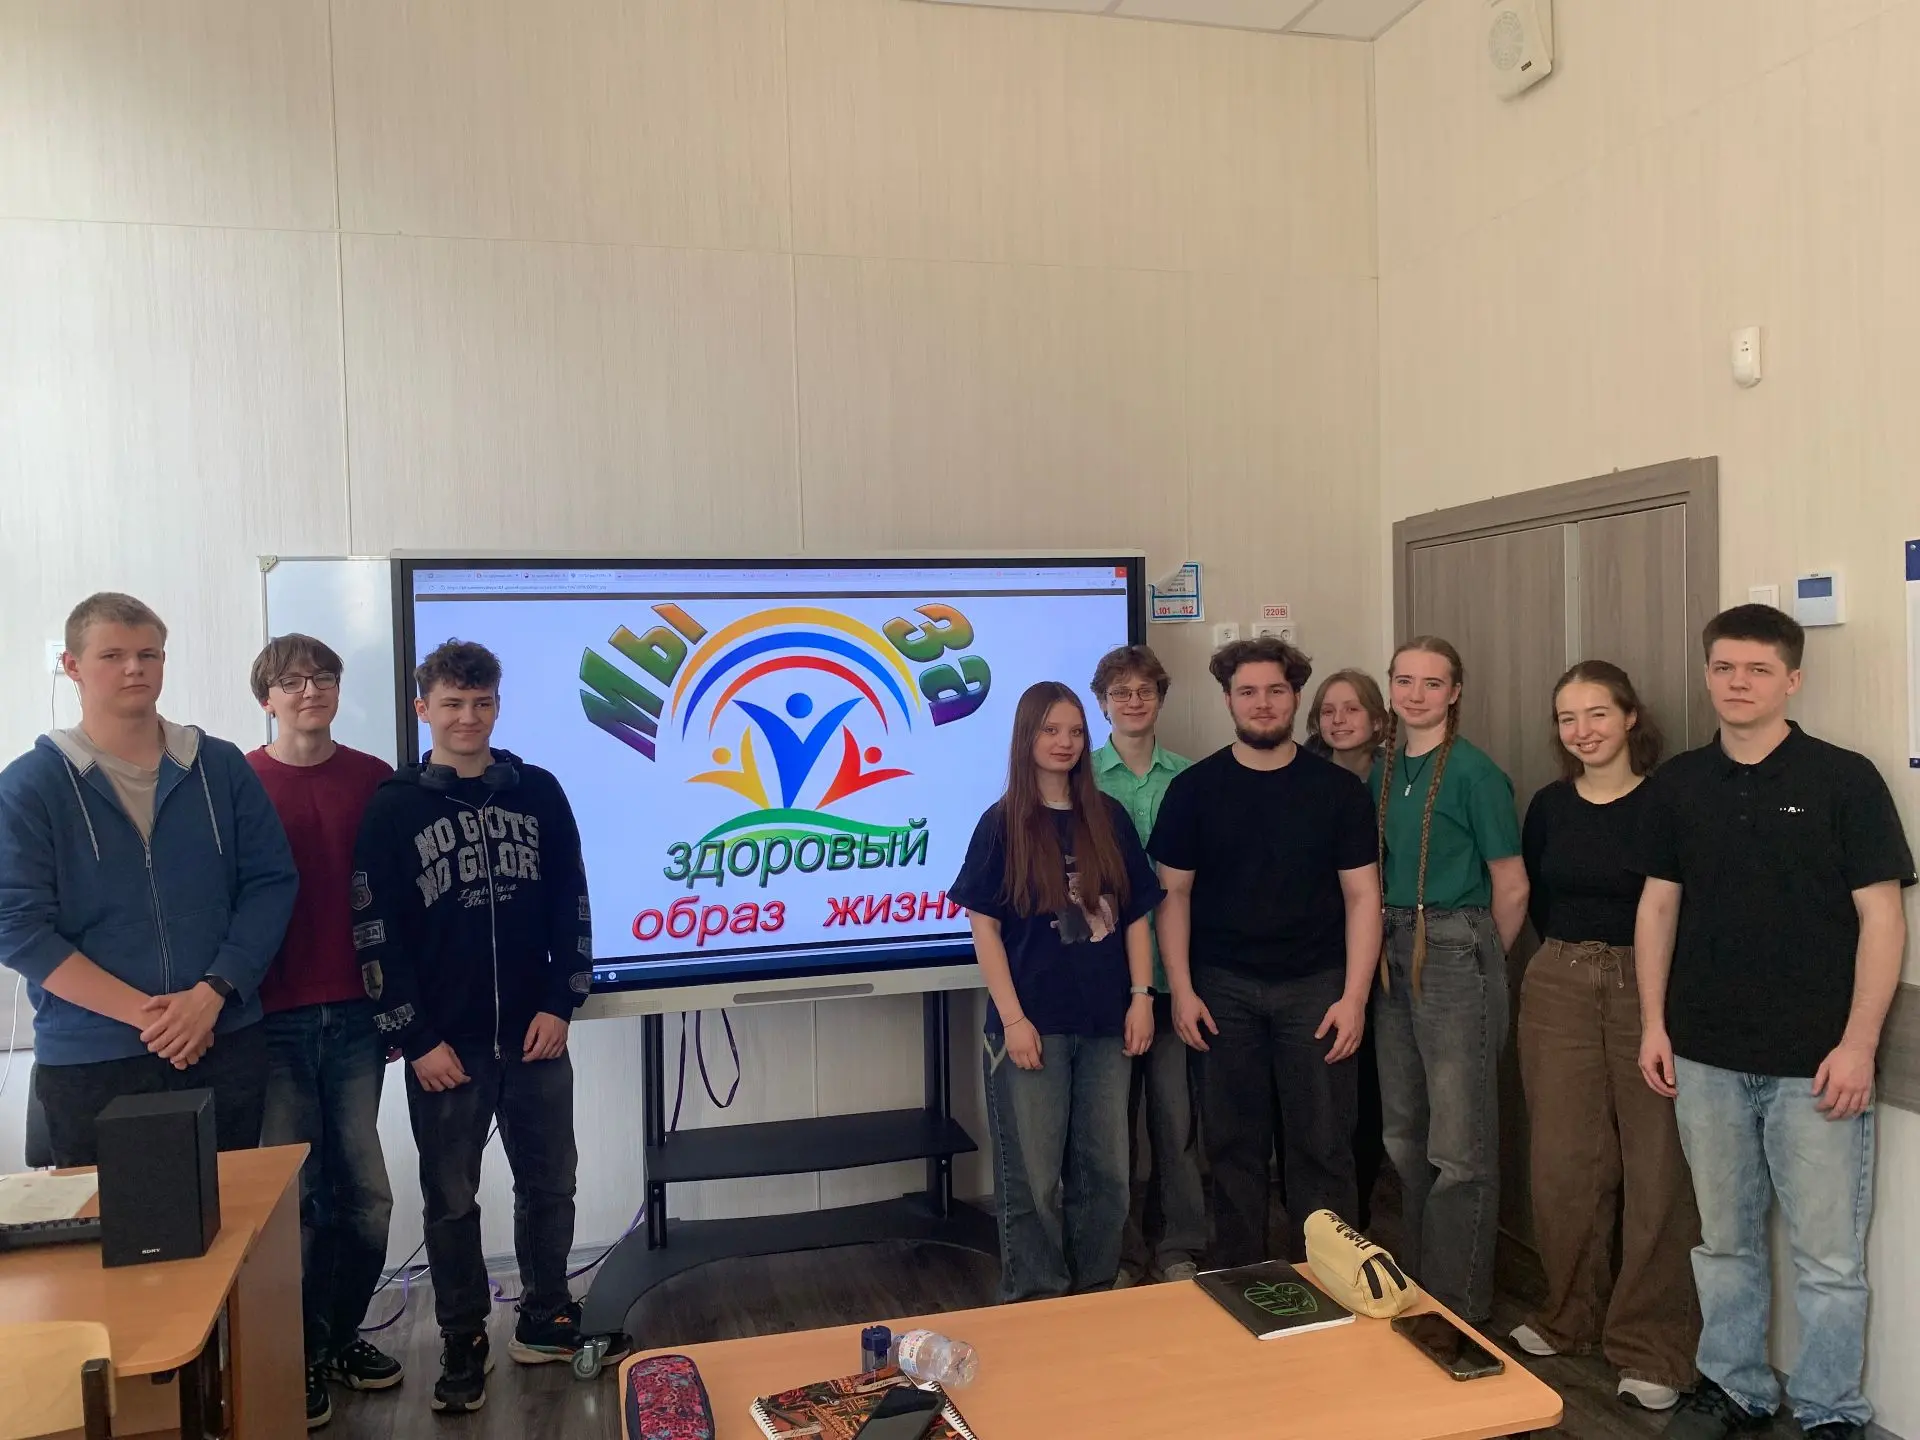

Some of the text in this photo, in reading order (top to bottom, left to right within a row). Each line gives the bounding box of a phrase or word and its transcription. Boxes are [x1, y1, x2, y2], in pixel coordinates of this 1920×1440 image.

[414, 806, 539, 869] NO GUTS
[663, 817, 929, 889] здоровый
[416, 857, 452, 908] NO
[458, 842, 541, 883] GLOR
[632, 895, 786, 946] образ
